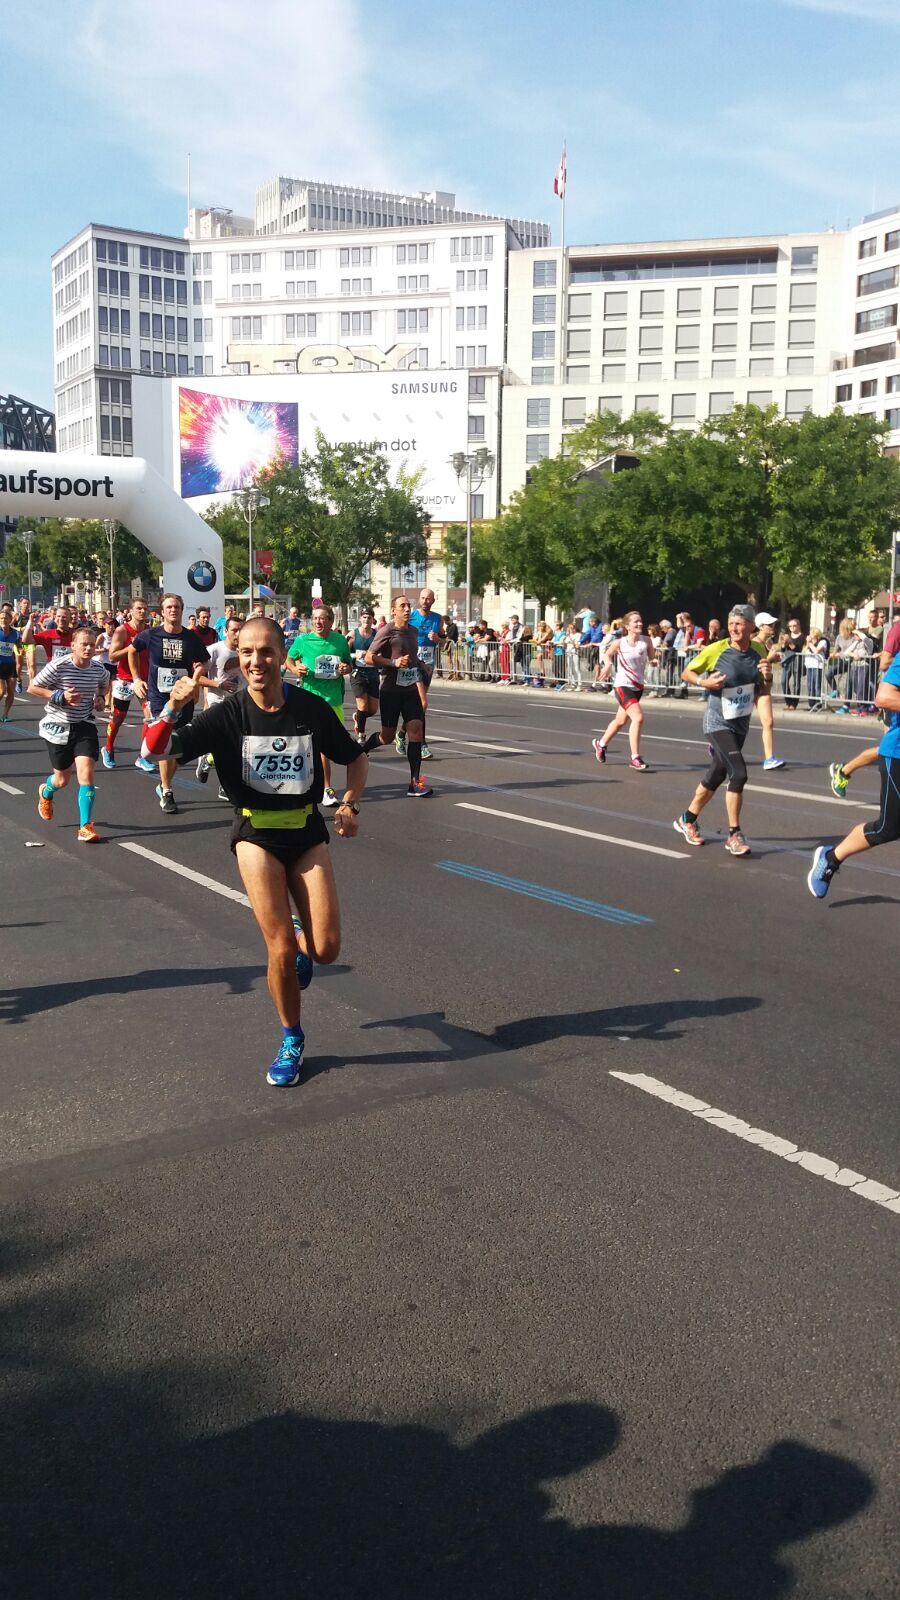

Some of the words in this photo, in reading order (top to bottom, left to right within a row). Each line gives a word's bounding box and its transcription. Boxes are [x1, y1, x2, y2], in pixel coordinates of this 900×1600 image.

[391, 381, 457, 395] SAMSUNG
[390, 438, 417, 451] dot
[190, 561, 215, 572] BMW
[163, 649, 183, 659] DAME
[255, 755, 304, 772] 7559
